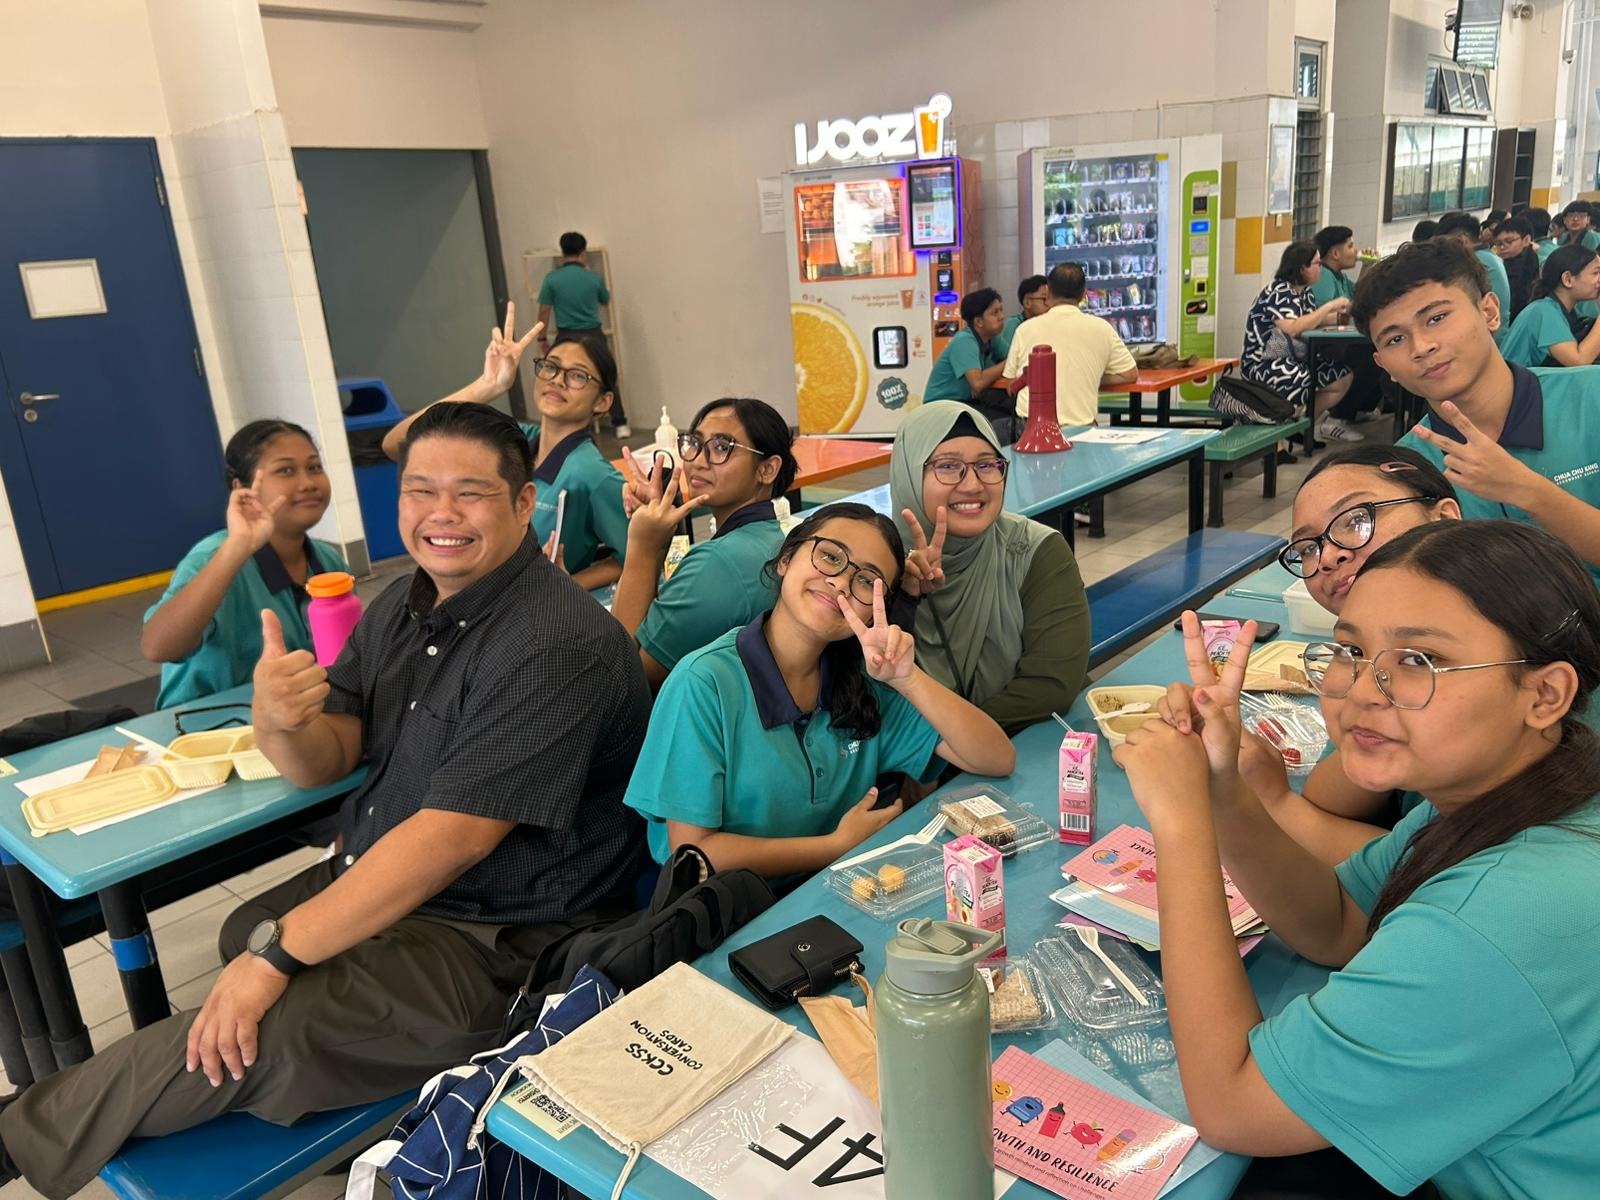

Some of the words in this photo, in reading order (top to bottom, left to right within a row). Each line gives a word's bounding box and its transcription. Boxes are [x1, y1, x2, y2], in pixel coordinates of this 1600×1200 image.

[794, 112, 916, 165] IJOOZ
[881, 384, 902, 399] 100%
[1554, 471, 1571, 482] CHUA
[1572, 467, 1583, 477] CHU
[625, 1043, 674, 1076] CCKSS
[630, 1020, 703, 1070] CONVERSATION
[660, 1030, 693, 1052] CARDS
[748, 1116, 884, 1188] 4F
[992, 1127, 1026, 1150] OWTH
[1024, 1145, 1051, 1162] AND
[1051, 1157, 1119, 1193] RESILIENCE
